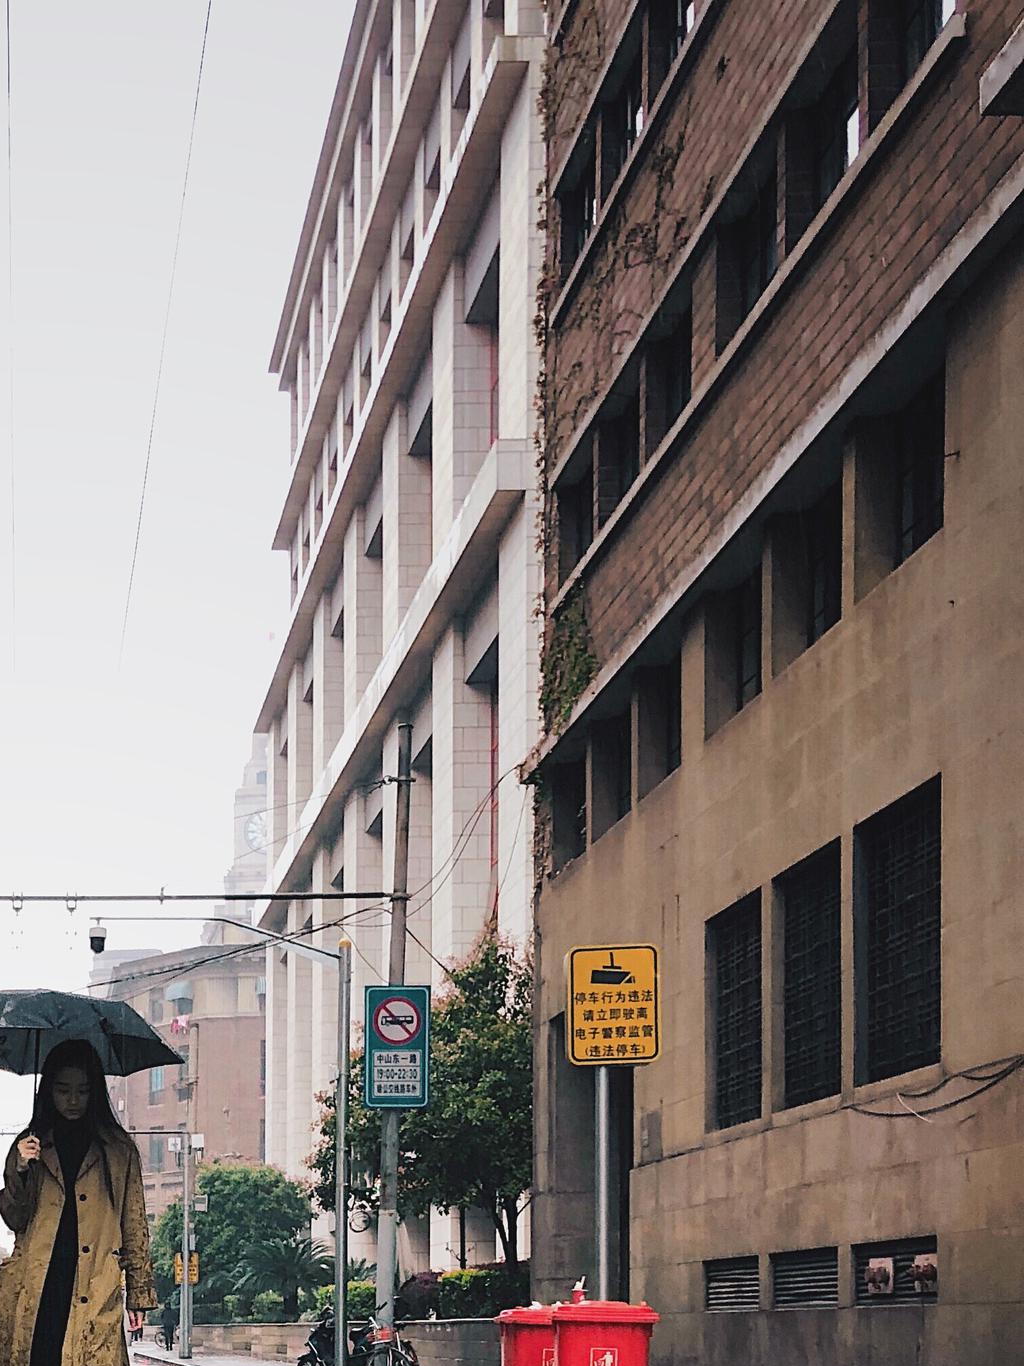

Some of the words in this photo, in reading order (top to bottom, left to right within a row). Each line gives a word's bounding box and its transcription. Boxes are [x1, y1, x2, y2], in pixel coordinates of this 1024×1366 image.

[575, 989, 653, 1005] 停车行为违法
[583, 1007, 648, 1022] 请立即驶离
[575, 1025, 653, 1040] 电子警察监管
[376, 1053, 417, 1064] 中山东一路
[376, 1068, 417, 1079] 19:00-22:30
